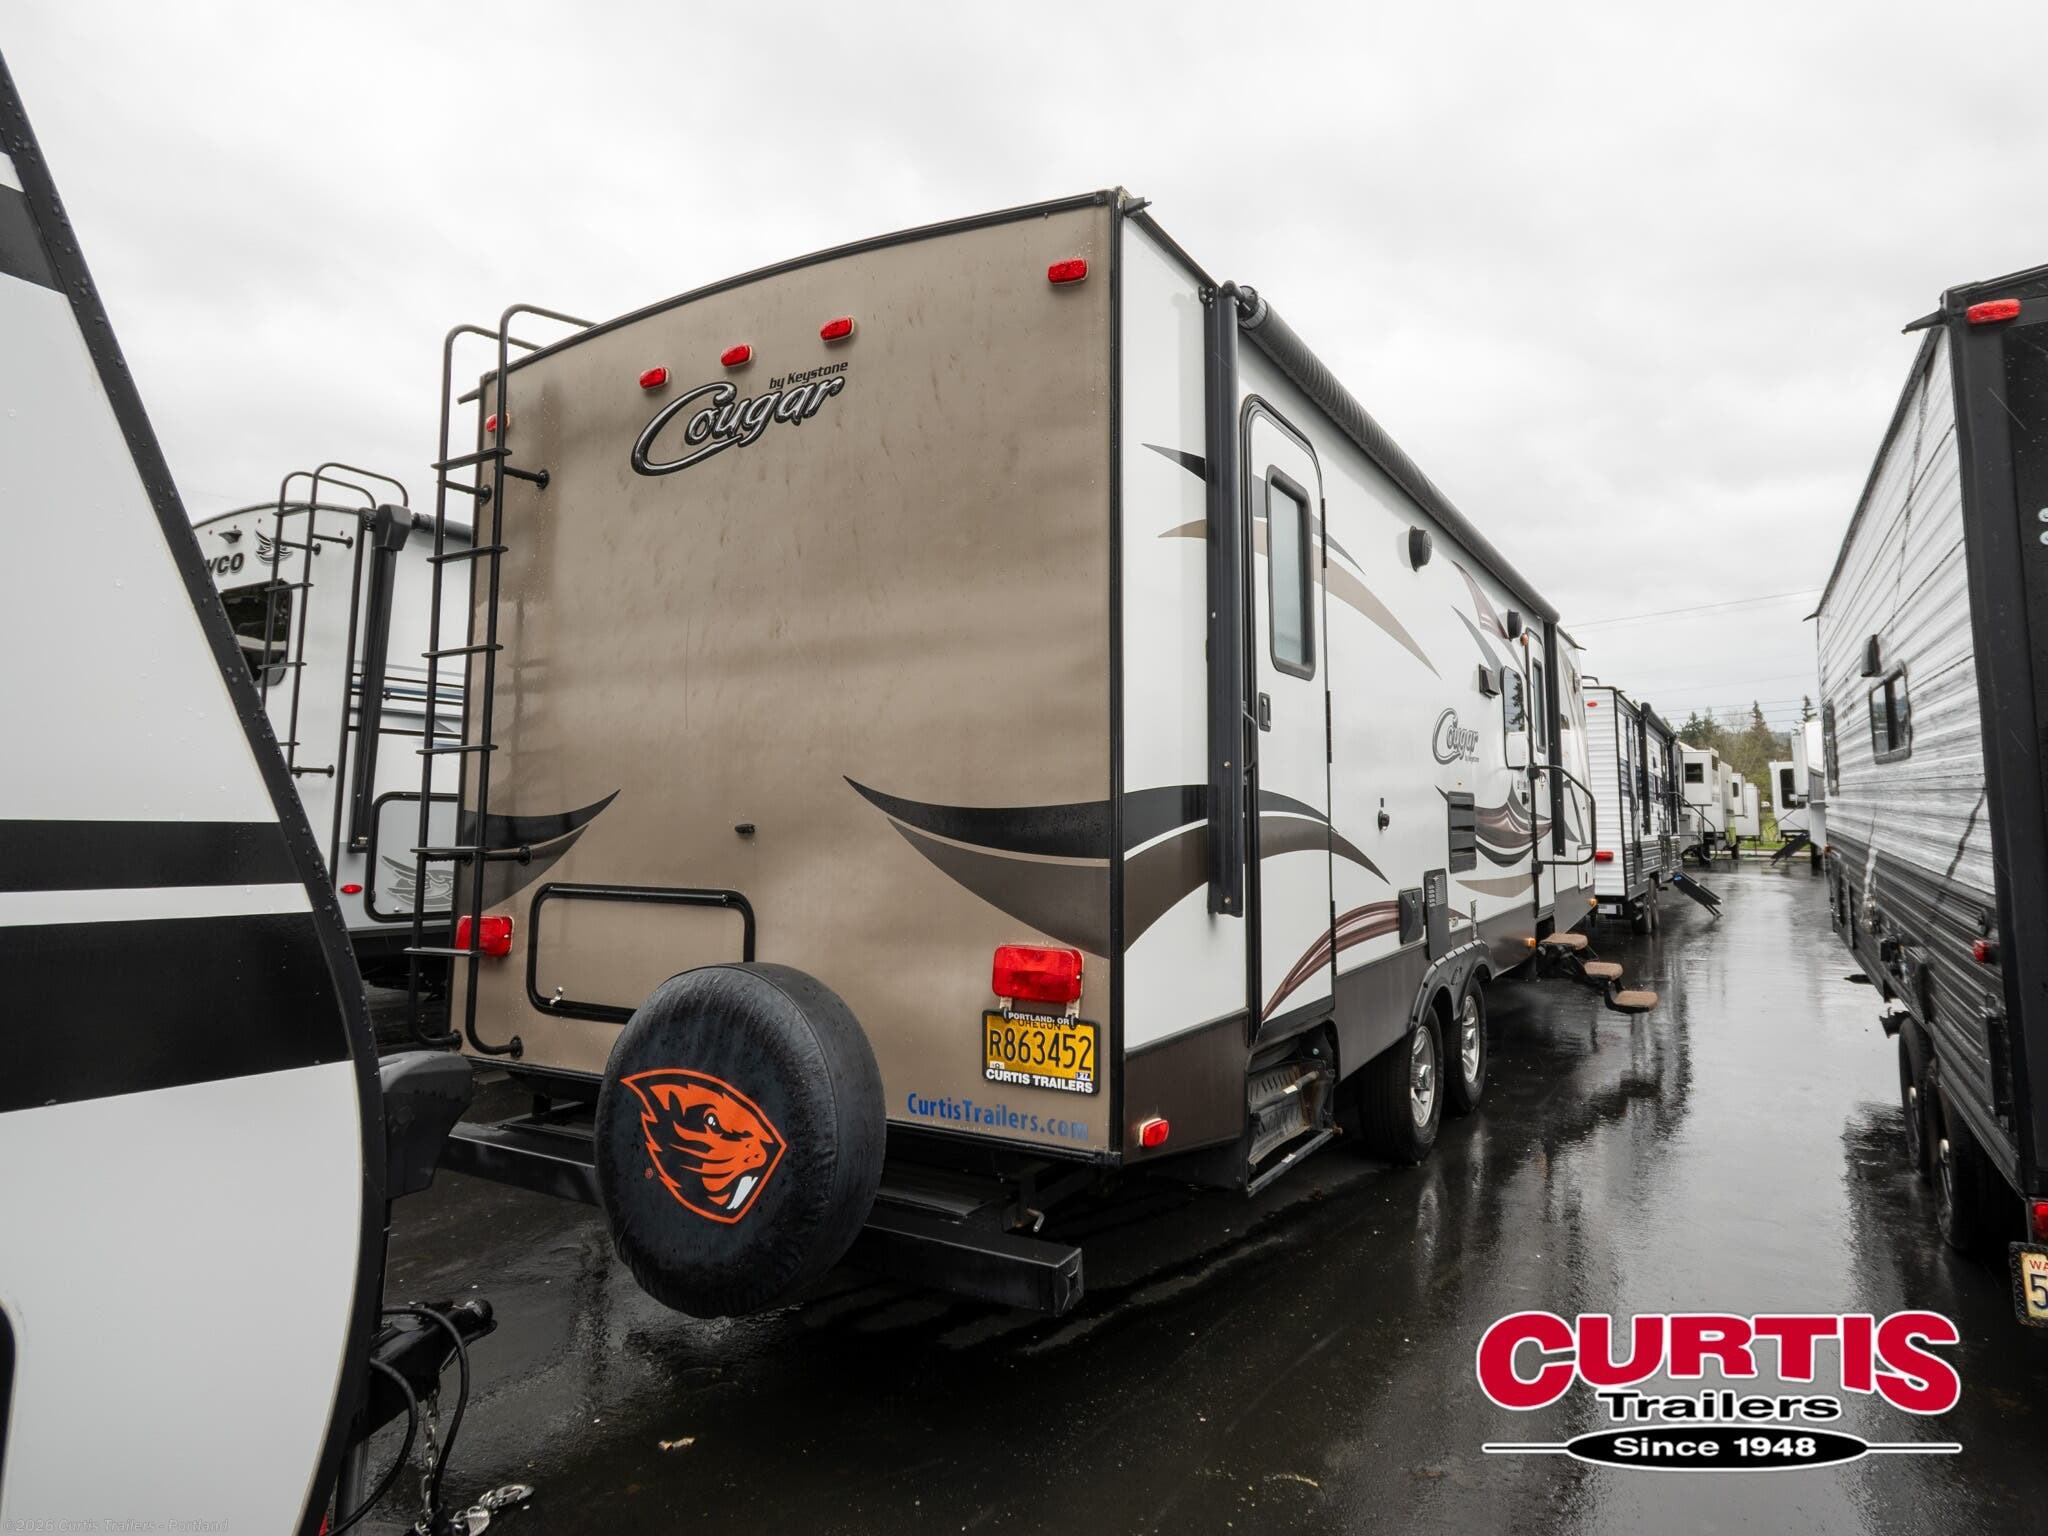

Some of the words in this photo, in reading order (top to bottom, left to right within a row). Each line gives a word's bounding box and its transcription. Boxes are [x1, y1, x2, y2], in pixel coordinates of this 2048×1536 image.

[769, 377, 784, 390] by
[787, 361, 848, 385] Keystone
[631, 376, 845, 476] Cougar
[1432, 708, 1478, 765] Cougar
[1057, 1017, 1069, 1025] OR
[989, 1027, 1092, 1071] R863452
[986, 1069, 1031, 1085] CURTIS
[1033, 1075, 1093, 1093] TRAILERS
[907, 1093, 1088, 1141] CurtisTrailers.com
